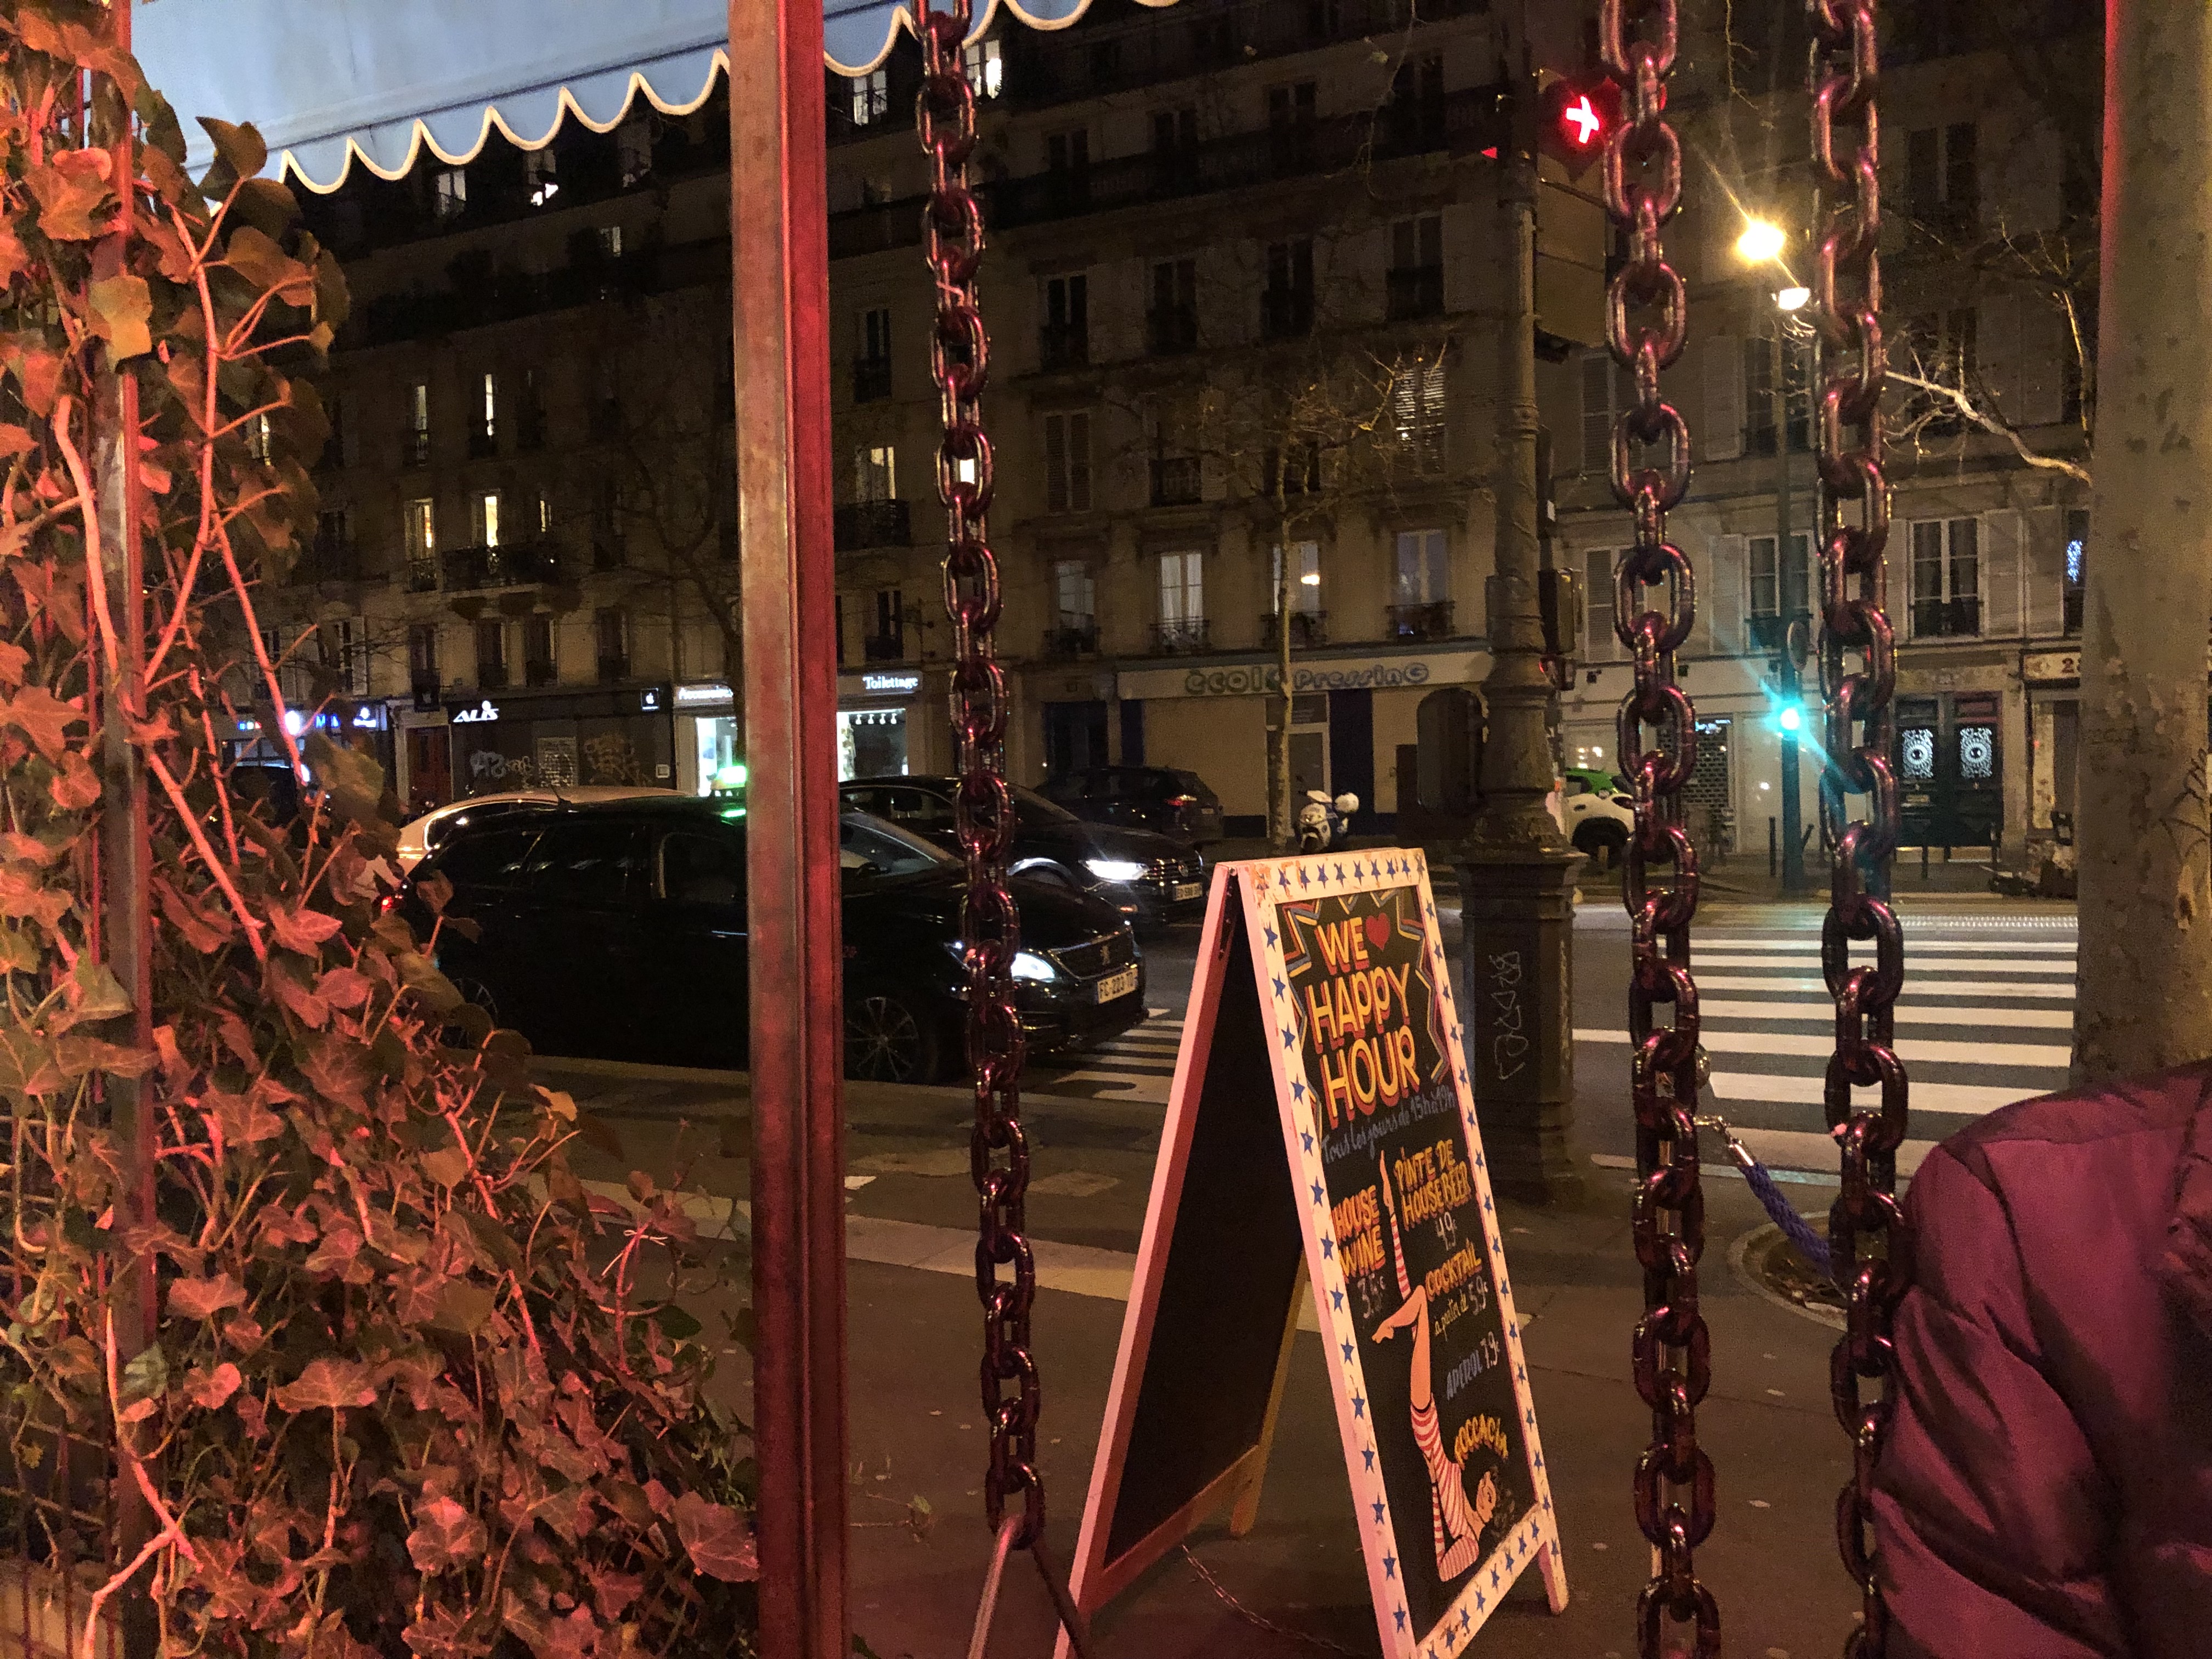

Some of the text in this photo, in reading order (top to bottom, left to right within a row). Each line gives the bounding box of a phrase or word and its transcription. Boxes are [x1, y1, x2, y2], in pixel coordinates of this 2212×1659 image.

[862, 675, 918, 689] Toilettage
[2061, 658, 2081, 673] 2
[1315, 916, 1369, 975] WE
[1305, 963, 1410, 1053] HAPPY
[1319, 1025, 1420, 1129] HOUR
[1436, 1138, 1456, 1171] DE
[1331, 1185, 1380, 1244] HOUSE
[1402, 1160, 1472, 1231] HOUSE BEER
[1338, 1224, 1386, 1284] WINE
